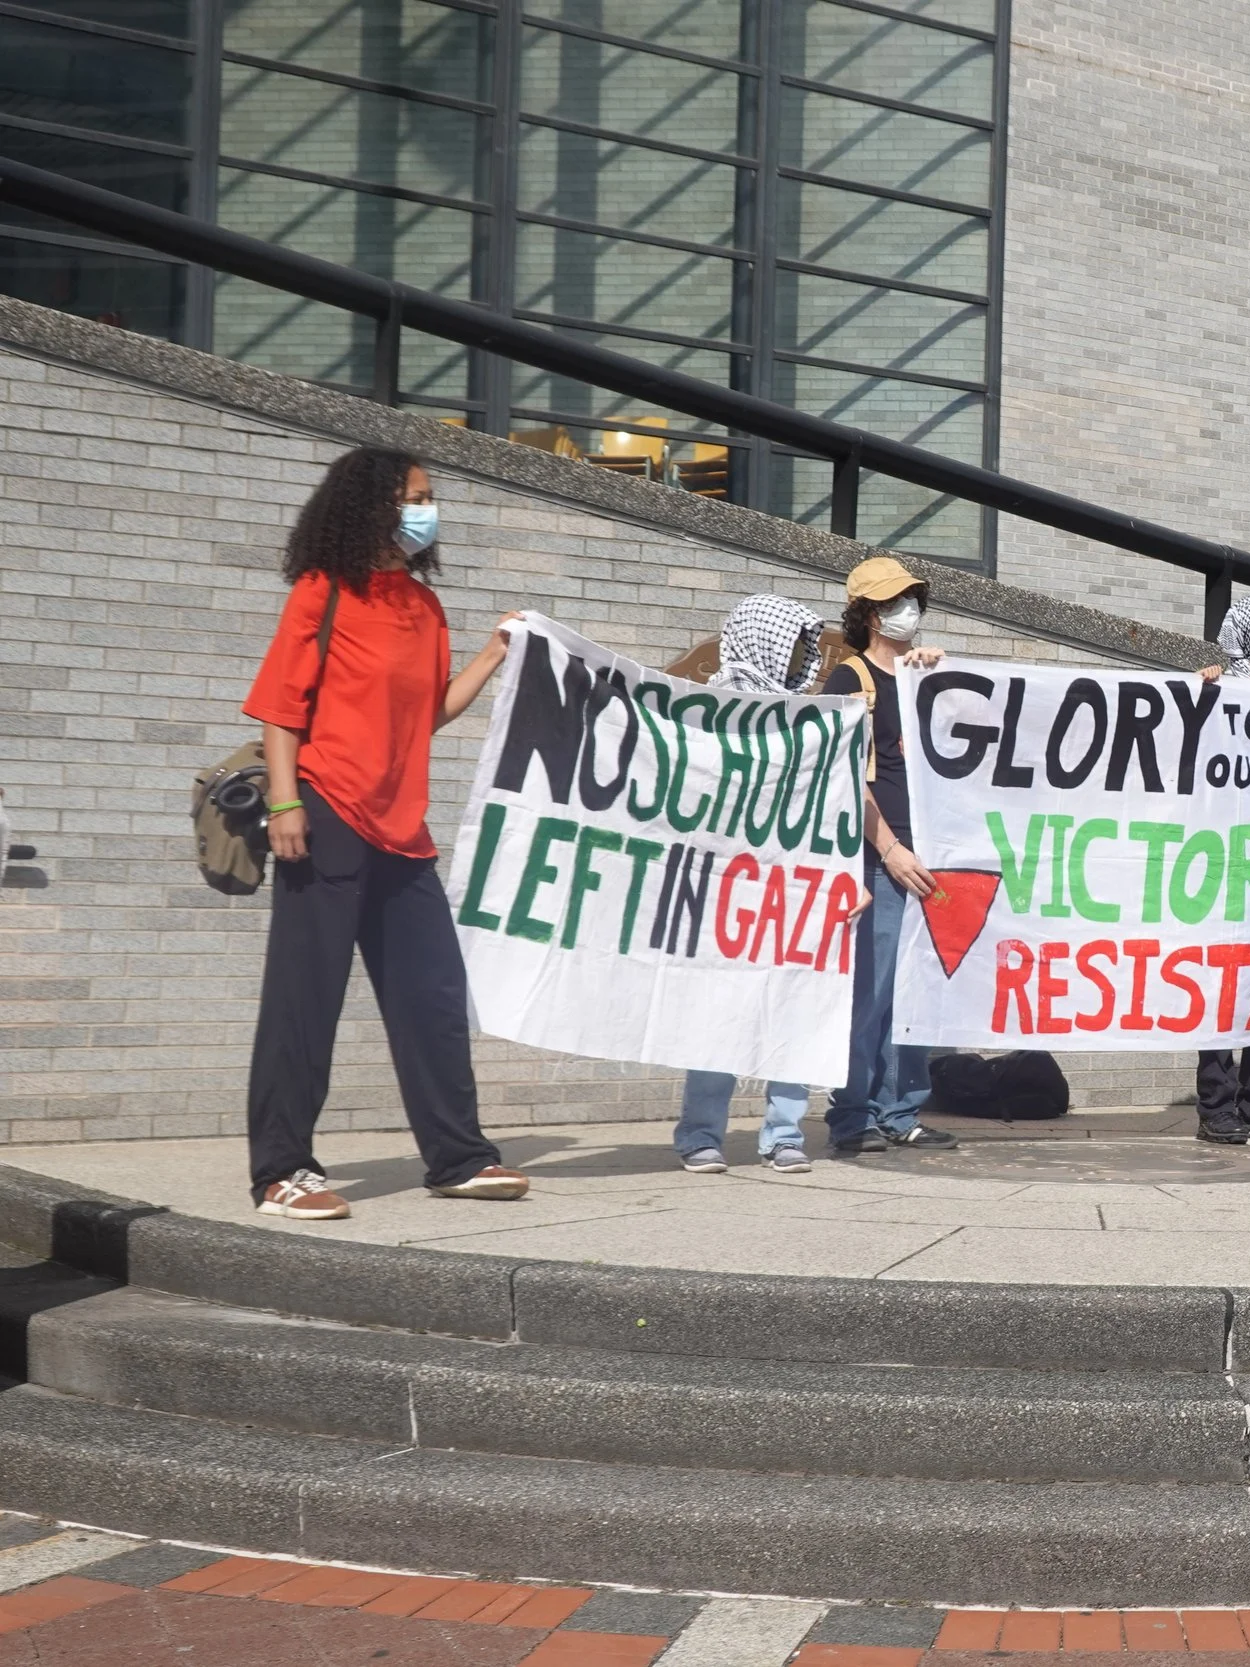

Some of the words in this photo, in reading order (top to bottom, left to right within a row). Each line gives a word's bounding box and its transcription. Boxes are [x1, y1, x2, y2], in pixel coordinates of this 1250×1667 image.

[494, 631, 639, 812] NO
[627, 682, 865, 858] SCHOOLS
[917, 671, 1222, 795] GLORY
[456, 802, 665, 955] LEFT
[650, 842, 716, 958] IN
[714, 852, 859, 975] GAZA
